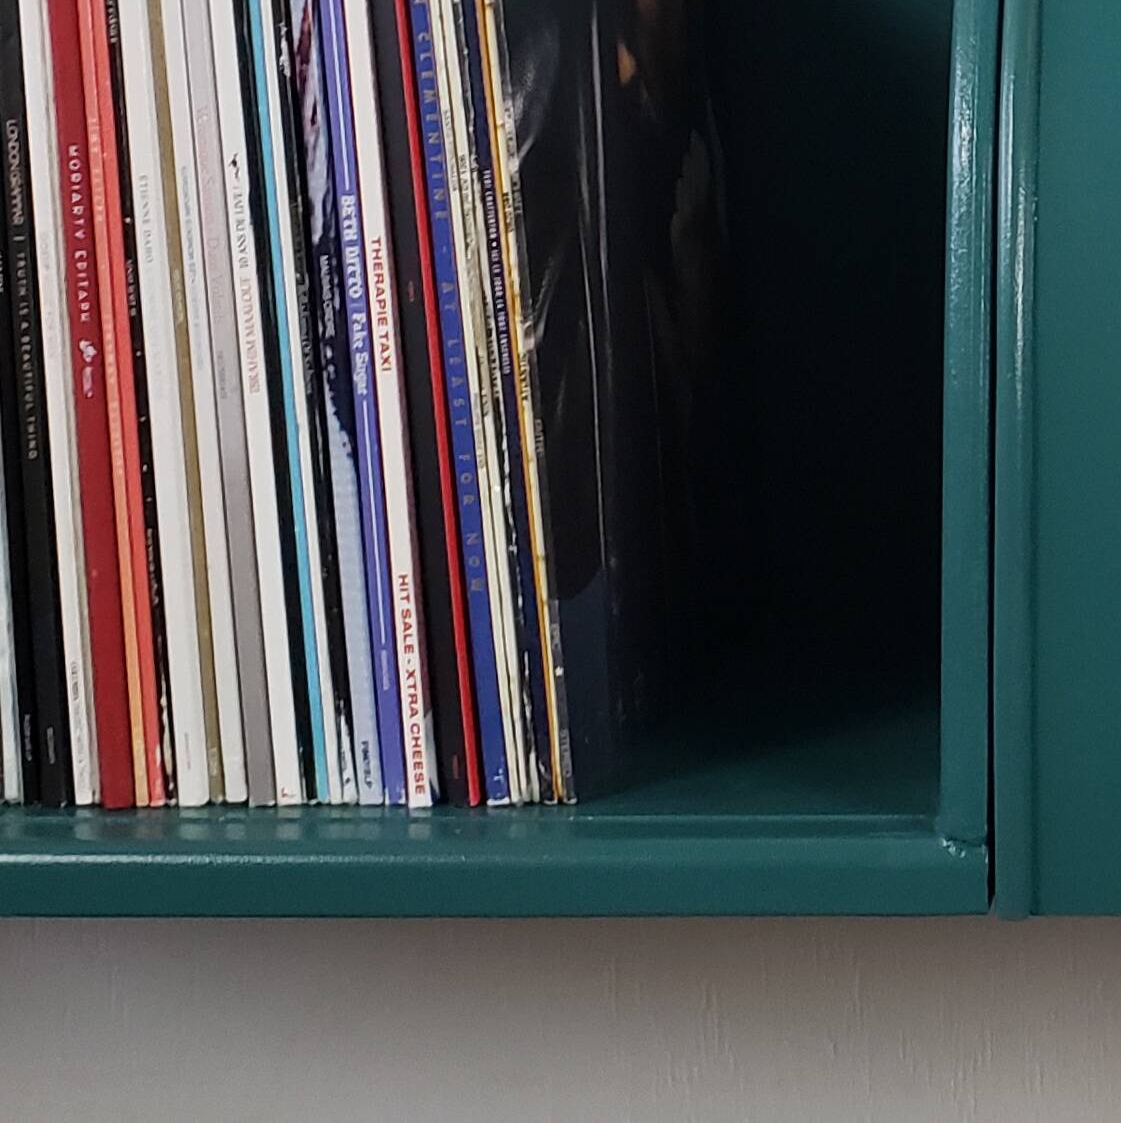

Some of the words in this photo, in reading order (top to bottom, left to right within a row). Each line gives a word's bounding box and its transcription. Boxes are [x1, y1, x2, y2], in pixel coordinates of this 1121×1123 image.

[417, 31, 449, 220] CLEMENTINE
[67, 145, 86, 239] MORIARTY
[341, 195, 356, 241] BETH
[343, 246, 363, 298] DITTO
[370, 237, 388, 326] THERAPIE
[440, 280, 459, 311] AT
[20, 321, 31, 332] A
[351, 312, 369, 349] Fake
[378, 331, 393, 372] TAXI
[20, 336, 35, 411] BEAUTIFUL
[446, 339, 466, 426] LEAST
[25, 417, 38, 460] THING
[458, 453, 474, 506] FOR
[466, 533, 484, 592] NOW
[398, 574, 411, 604] HIT
[401, 608, 414, 654] SALE
[405, 668, 419, 719] XTRA
[410, 723, 426, 795] CHEESE
